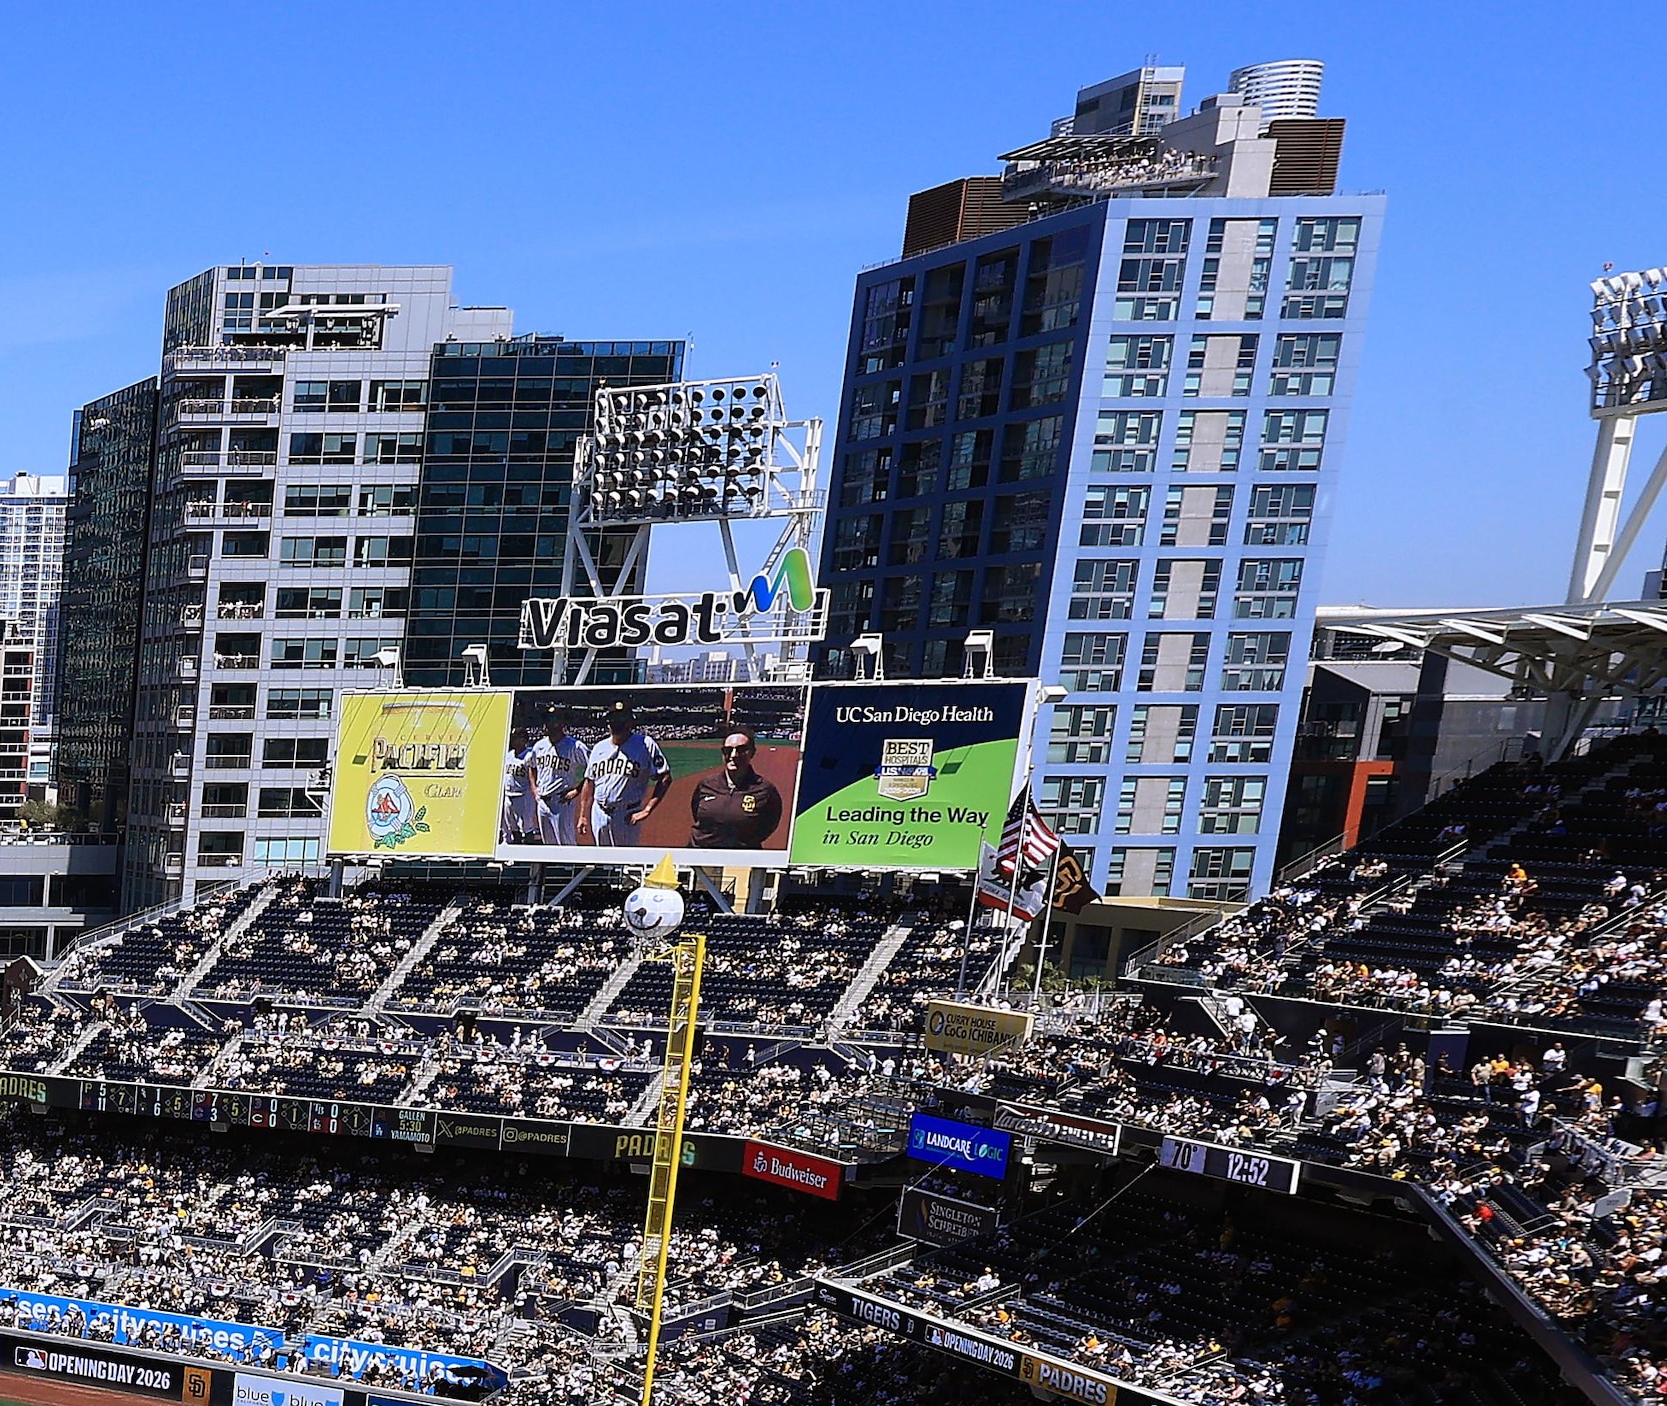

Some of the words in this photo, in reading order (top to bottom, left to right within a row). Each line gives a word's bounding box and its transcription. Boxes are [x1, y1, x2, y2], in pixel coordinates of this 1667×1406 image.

[523, 592, 724, 648] Viasat
[837, 707, 863, 723] UC
[865, 707, 892, 723] San
[895, 707, 939, 726] Diego
[941, 706, 993, 723] Health
[887, 742, 931, 755] BEST
[827, 806, 904, 826] Leading
[909, 808, 943, 823] the
[947, 808, 989, 828] Way
[823, 831, 840, 845] in
[846, 832, 879, 846] San
[886, 831, 933, 848] Diego
[946, 1013, 970, 1026] CURRY
[971, 1017, 995, 1030] HOUSE
[99, 1084, 106, 1096] 5
[98, 1098, 106, 1111] 11
[211, 1093, 218, 1106] 7
[154, 1104, 160, 1116] 6
[210, 1108, 217, 1121] 3
[399, 1110, 426, 1122] GALLEN
[399, 1120, 422, 1132] 5:30
[454, 1126, 497, 1139] @PADRES
[390, 1129, 430, 1143] YAMAMOTO
[517, 1130, 567, 1145] @PADRES
[926, 1132, 973, 1157] LANDCARE
[770, 1158, 828, 1190] Budweiser
[1227, 1153, 1269, 1186] 12:52
[851, 1297, 900, 1331] TIGERS
[944, 1335, 977, 1359] OPENING
[976, 1345, 995, 1362] DAY
[995, 1350, 1014, 1370] 2026
[49, 1353, 107, 1377] OPENING
[107, 1360, 136, 1382] DAY
[137, 1366, 170, 1389] 2026
[1040, 1364, 1108, 1405] PADRES
[236, 1386, 270, 1402] blue
